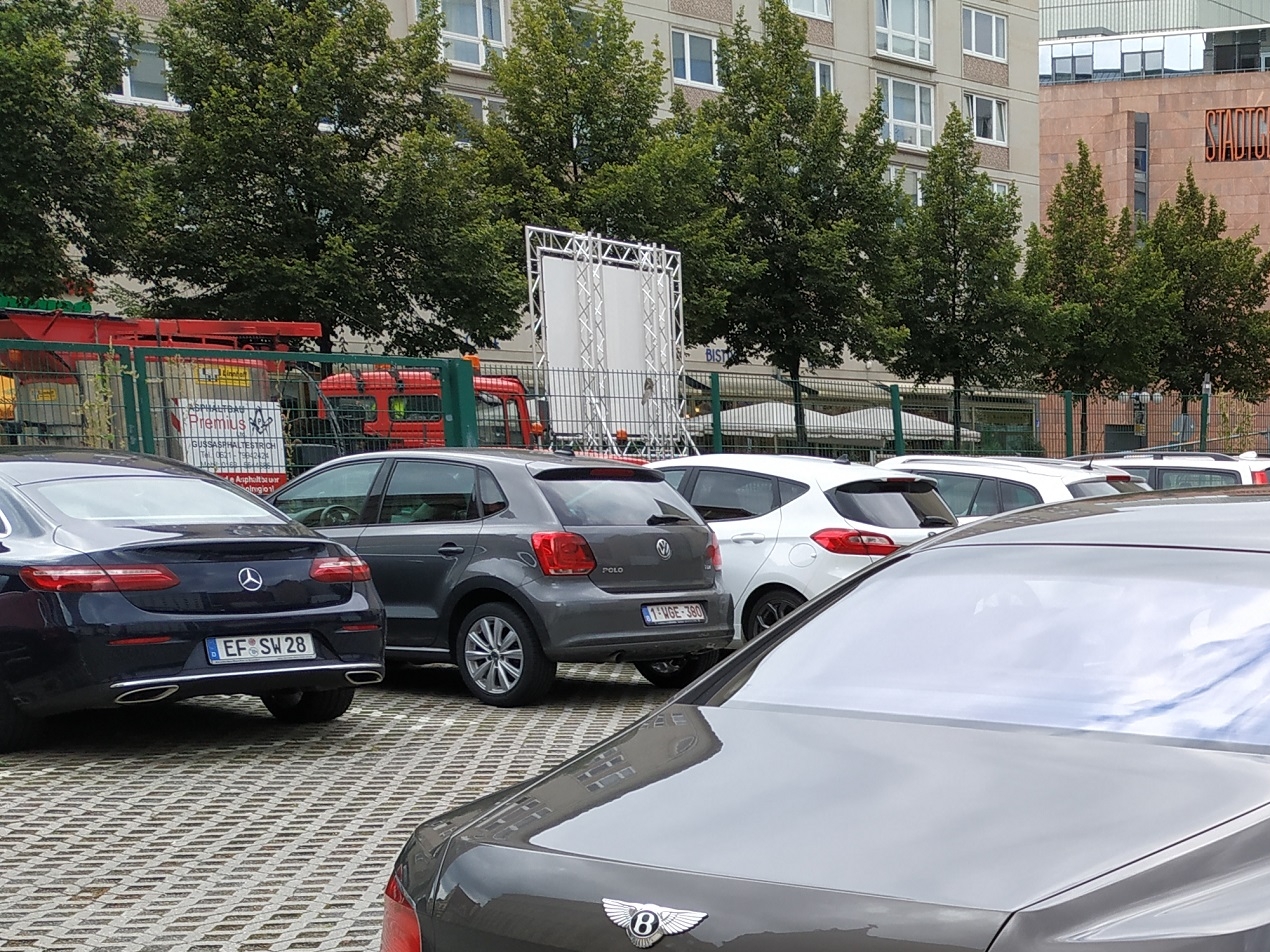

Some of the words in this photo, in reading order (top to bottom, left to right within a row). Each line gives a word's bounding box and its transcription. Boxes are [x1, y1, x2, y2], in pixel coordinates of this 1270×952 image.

[706, 348, 732, 362] BIST
[189, 414, 247, 431] Premius
[223, 639, 248, 657] EF
[260, 637, 282, 655] SW
[284, 636, 307, 653] 28
